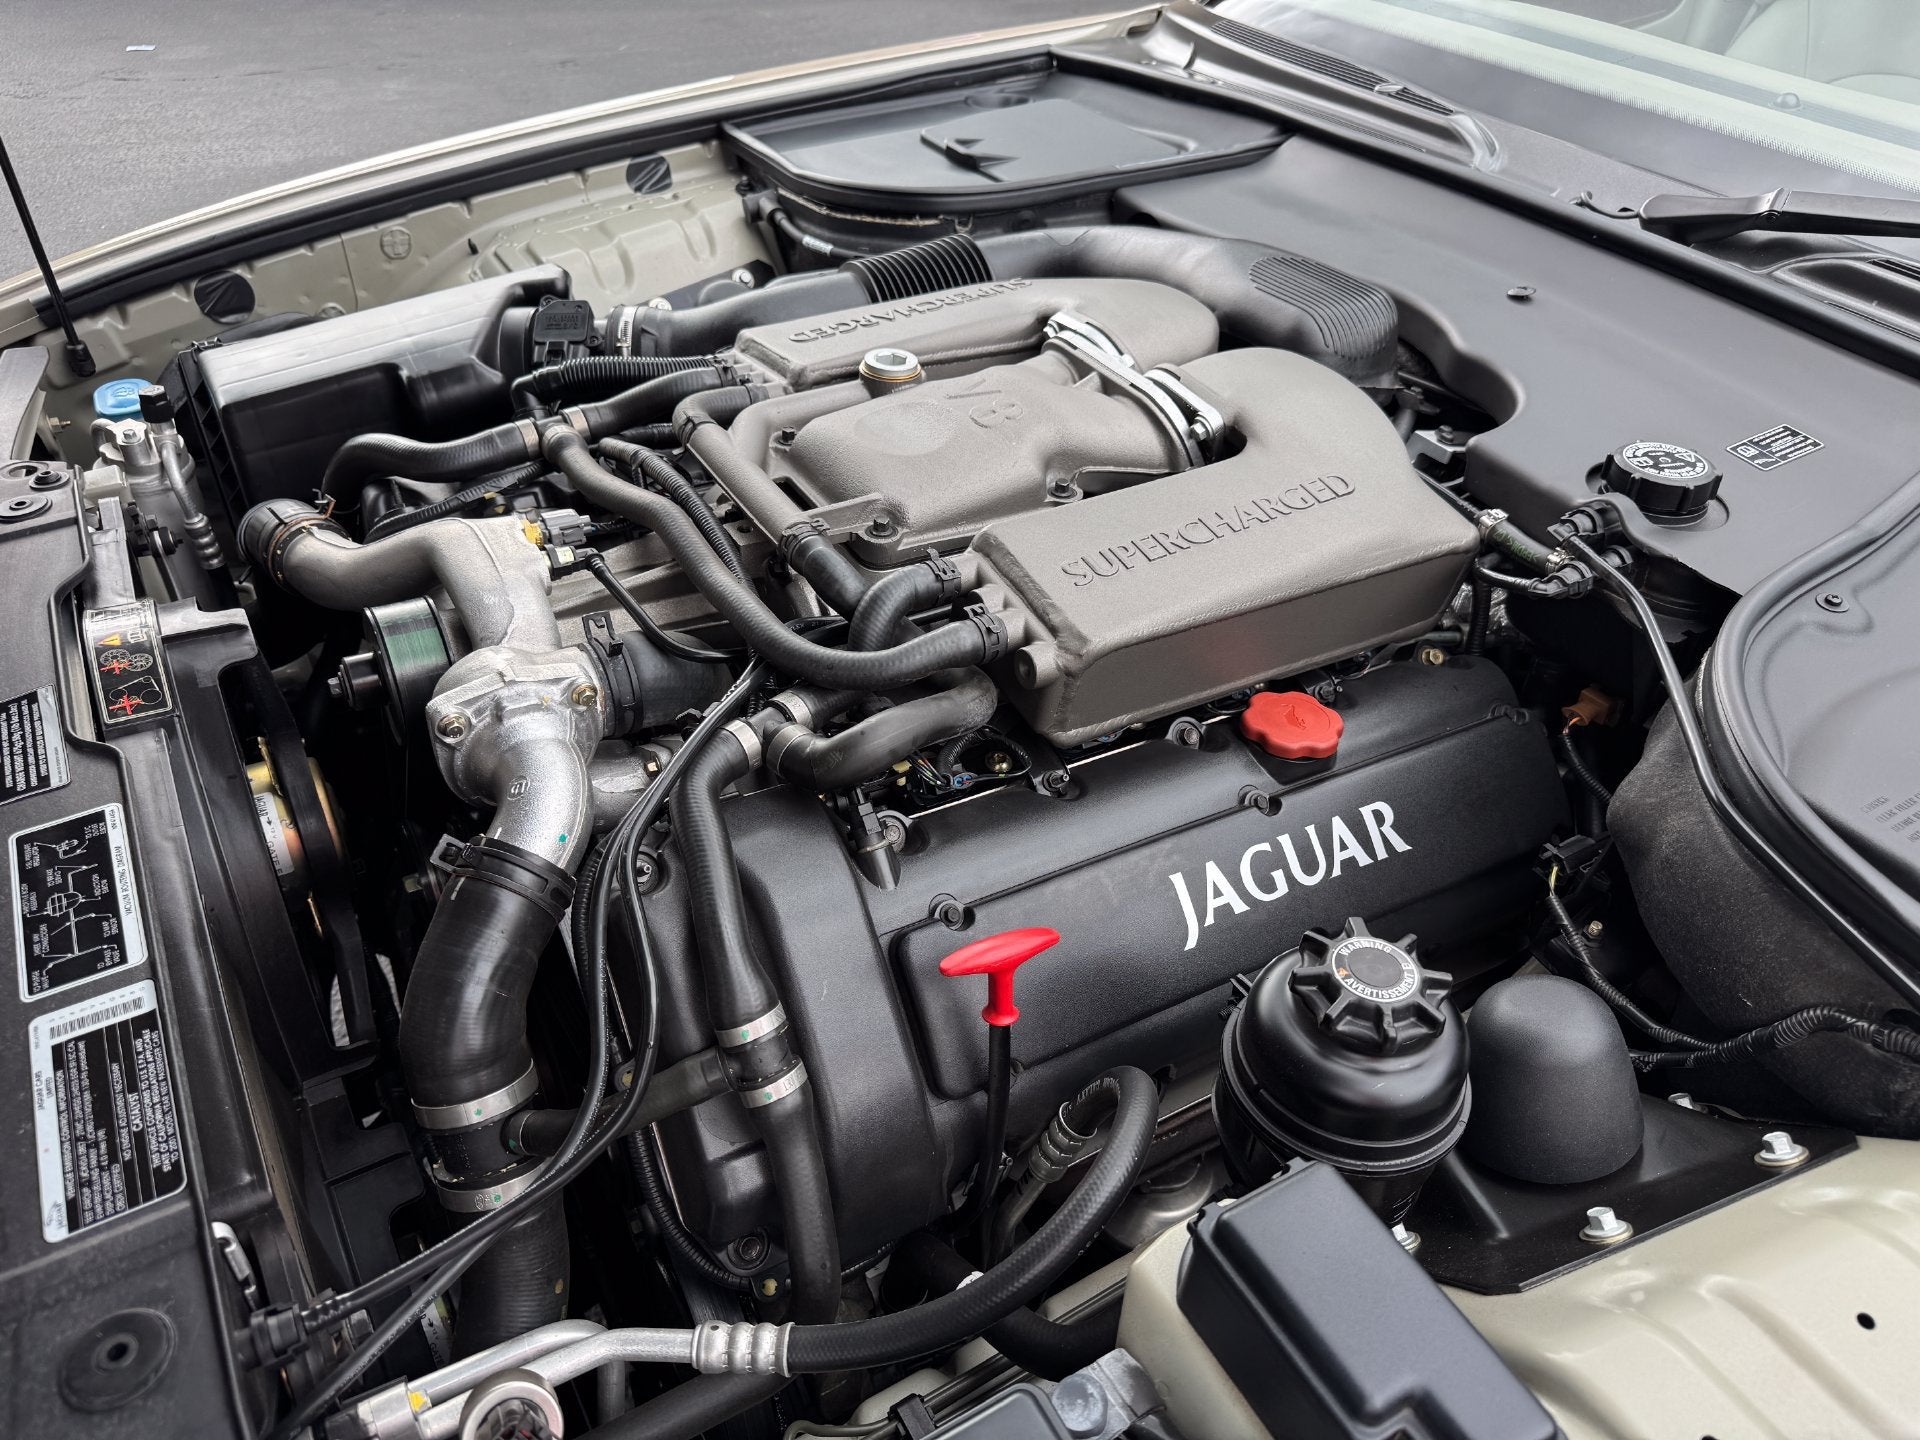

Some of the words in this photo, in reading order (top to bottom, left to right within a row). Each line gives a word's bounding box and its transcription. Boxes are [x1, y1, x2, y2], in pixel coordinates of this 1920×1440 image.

[788, 277, 1033, 344] SUPERCHARGED
[945, 377, 1024, 433] V8
[1062, 474, 1357, 587] SUPERCHARGED
[114, 844, 125, 868] DIAGRAM
[118, 867, 129, 893] ROUTING
[1168, 801, 1413, 951] JAGUAR
[122, 892, 133, 915] VACUUM
[1339, 940, 1392, 956] WARNING
[1344, 973, 1415, 999] AVERTISSEMENT
[135, 1037, 144, 1052] AND
[142, 1028, 154, 1062] APPLICABLE
[151, 1029, 160, 1047] CARS
[154, 1046, 166, 1080] PASSENGER
[34, 1069, 43, 1087] CARS
[45, 1075, 53, 1098] LIMITED
[55, 1068, 67, 1111] INFORMATION
[111, 1061, 123, 1093] NECESSARY
[147, 1061, 160, 1103] REGULATIONS
[159, 1080, 168, 1095] NEW
[35, 1086, 45, 1111] JAGUAR
[115, 1091, 127, 1127] ADJUSTMENT
[128, 1090, 143, 1132] CATALYST
[142, 1089, 155, 1126] CONFORMS
[161, 1094, 171, 1111] YEAR
[59, 1109, 70, 1141] CONTROL
[153, 1102, 166, 1142] CALIFORNIA
[164, 1110, 175, 1135] MODEL
[120, 1126, 130, 1149] ENGINE
[148, 1125, 159, 1153] VEHICLE
[168, 1135, 177, 1151] 2001
[62, 1140, 72, 1172] EMISSION
[88, 1146, 98, 1168] FAMILY
[123, 1148, 132, 1161] NO
[151, 1152, 161, 1167] THIS
[160, 1151, 171, 1172] STATE
[64, 1171, 75, 1200] VEHICLE
[111, 1162, 123, 1193] CERTIFIED
[81, 1185, 92, 1210] GROUP
[101, 1169, 114, 1216] DISPLACEMENT
[83, 1208, 93, 1224] TEST
